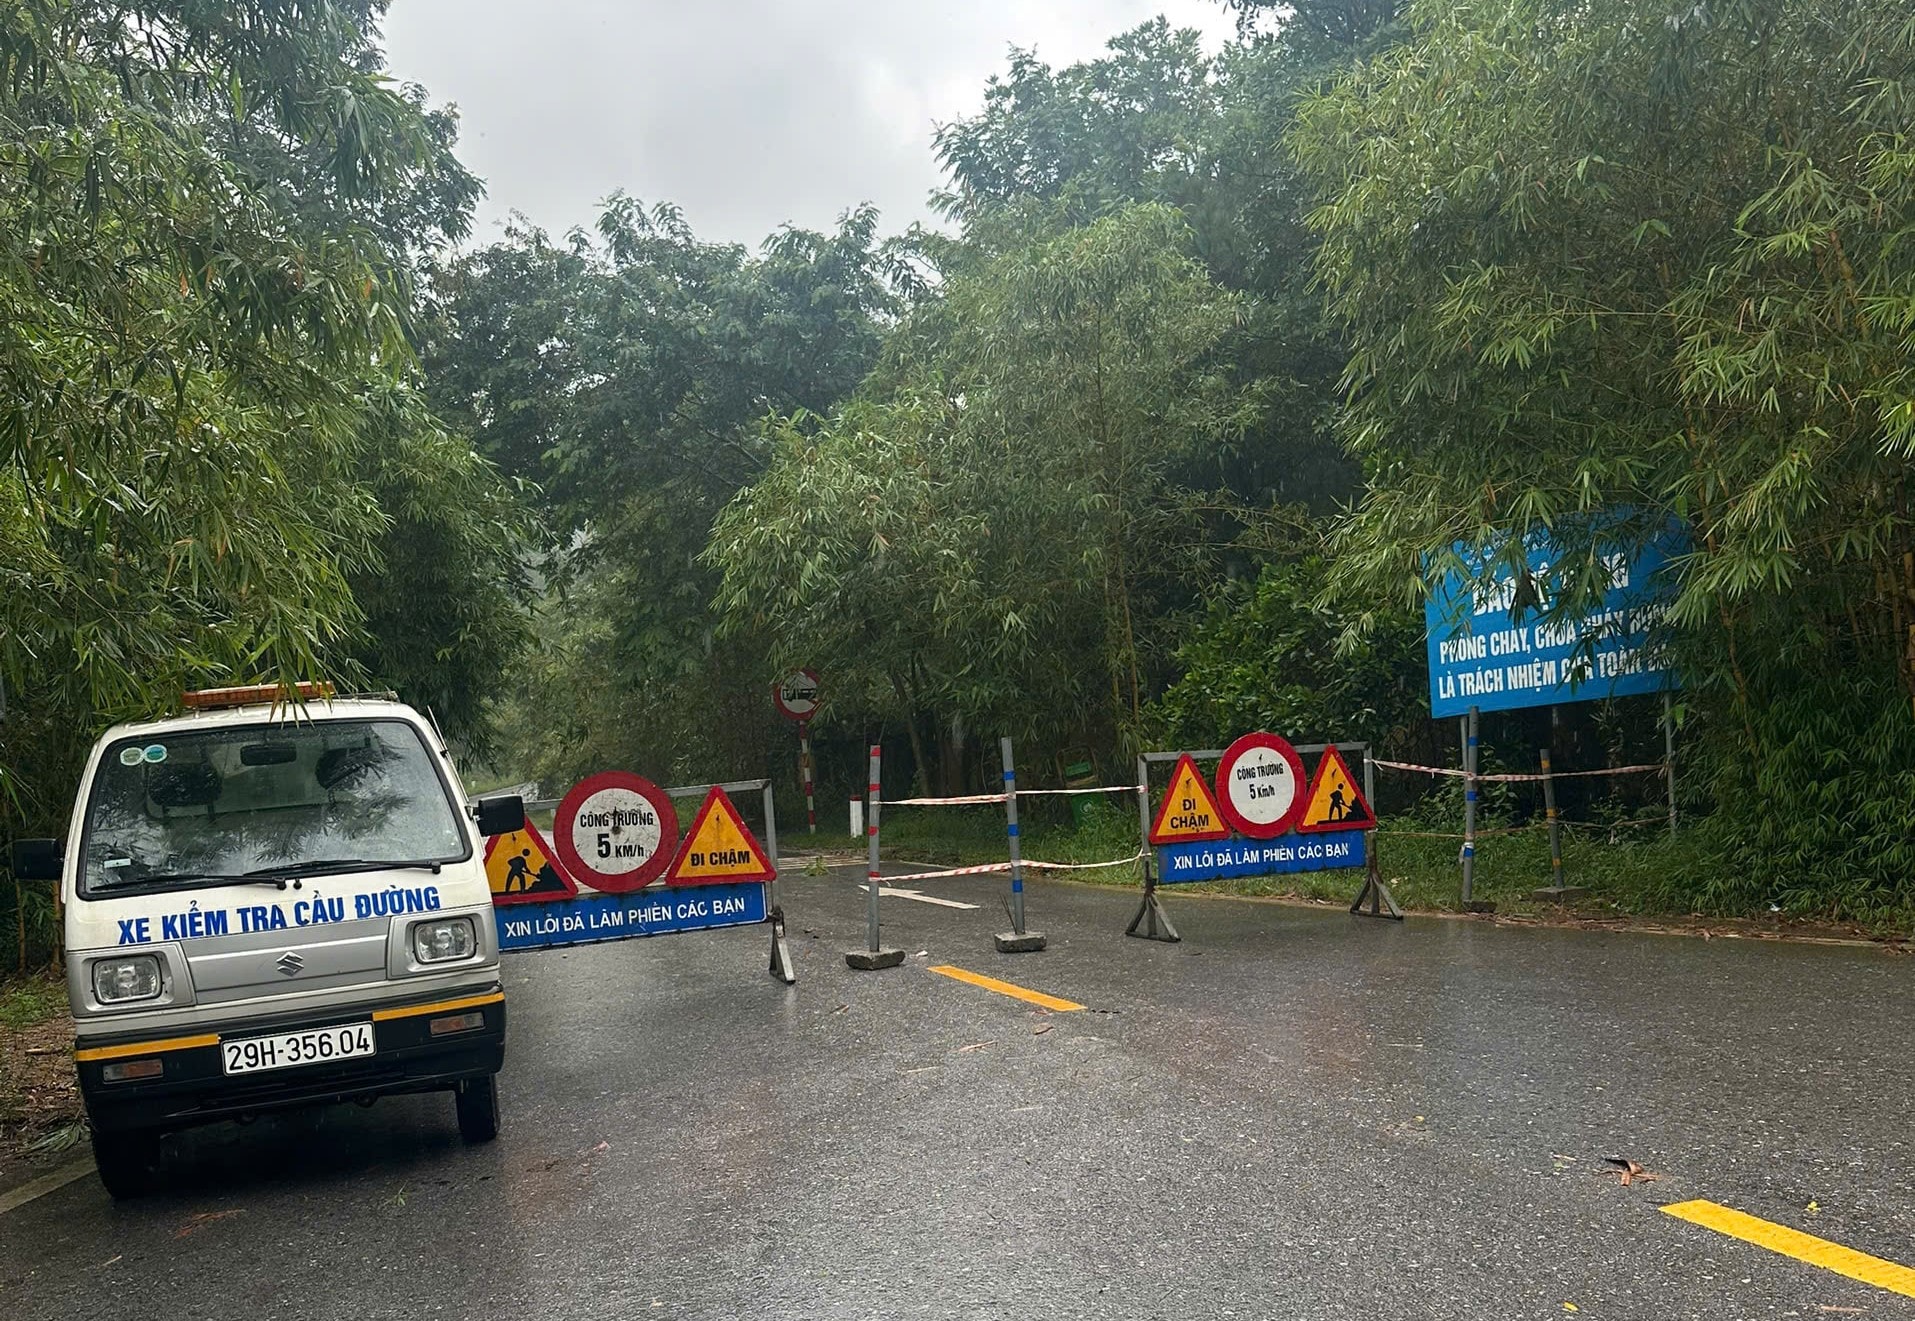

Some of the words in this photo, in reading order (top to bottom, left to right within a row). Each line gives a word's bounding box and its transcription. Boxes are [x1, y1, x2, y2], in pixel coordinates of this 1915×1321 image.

[1440, 633, 1487, 665] PHÒNG
[1438, 671, 1456, 699] LÀ
[1458, 666, 1503, 697] TRÁCH
[1507, 657, 1557, 692] NHIỆM
[1236, 765, 1256, 781] CÔNG
[1249, 783, 1257, 800] 5
[1182, 798, 1196, 811] ĐI
[580, 811, 609, 828] CÔNG
[1170, 812, 1209, 830] CHẬM
[597, 833, 611, 858] 5
[615, 845, 644, 858] KM/h
[690, 853, 705, 866] ĐI
[709, 848, 750, 867] CHẬM
[1173, 855, 1192, 870] XIN
[1216, 848, 1233, 867] ĐÃ
[1235, 847, 1259, 865] LÀM
[1297, 841, 1322, 860] CÁC
[1325, 842, 1349, 859] BẠN
[117, 917, 151, 945] XE
[161, 900, 228, 940] KIỂM
[236, 904, 287, 933] TRA
[294, 890, 345, 927] CẦU
[354, 884, 441, 919] ĐƯỜNG
[505, 921, 531, 938] XIN
[535, 913, 560, 934] LỖI
[562, 911, 585, 932] ĐÃ
[590, 909, 623, 929] LÀM
[676, 900, 708, 919] CÁC
[712, 897, 745, 917] BẠN
[227, 1027, 370, 1071] 29H-356.04
